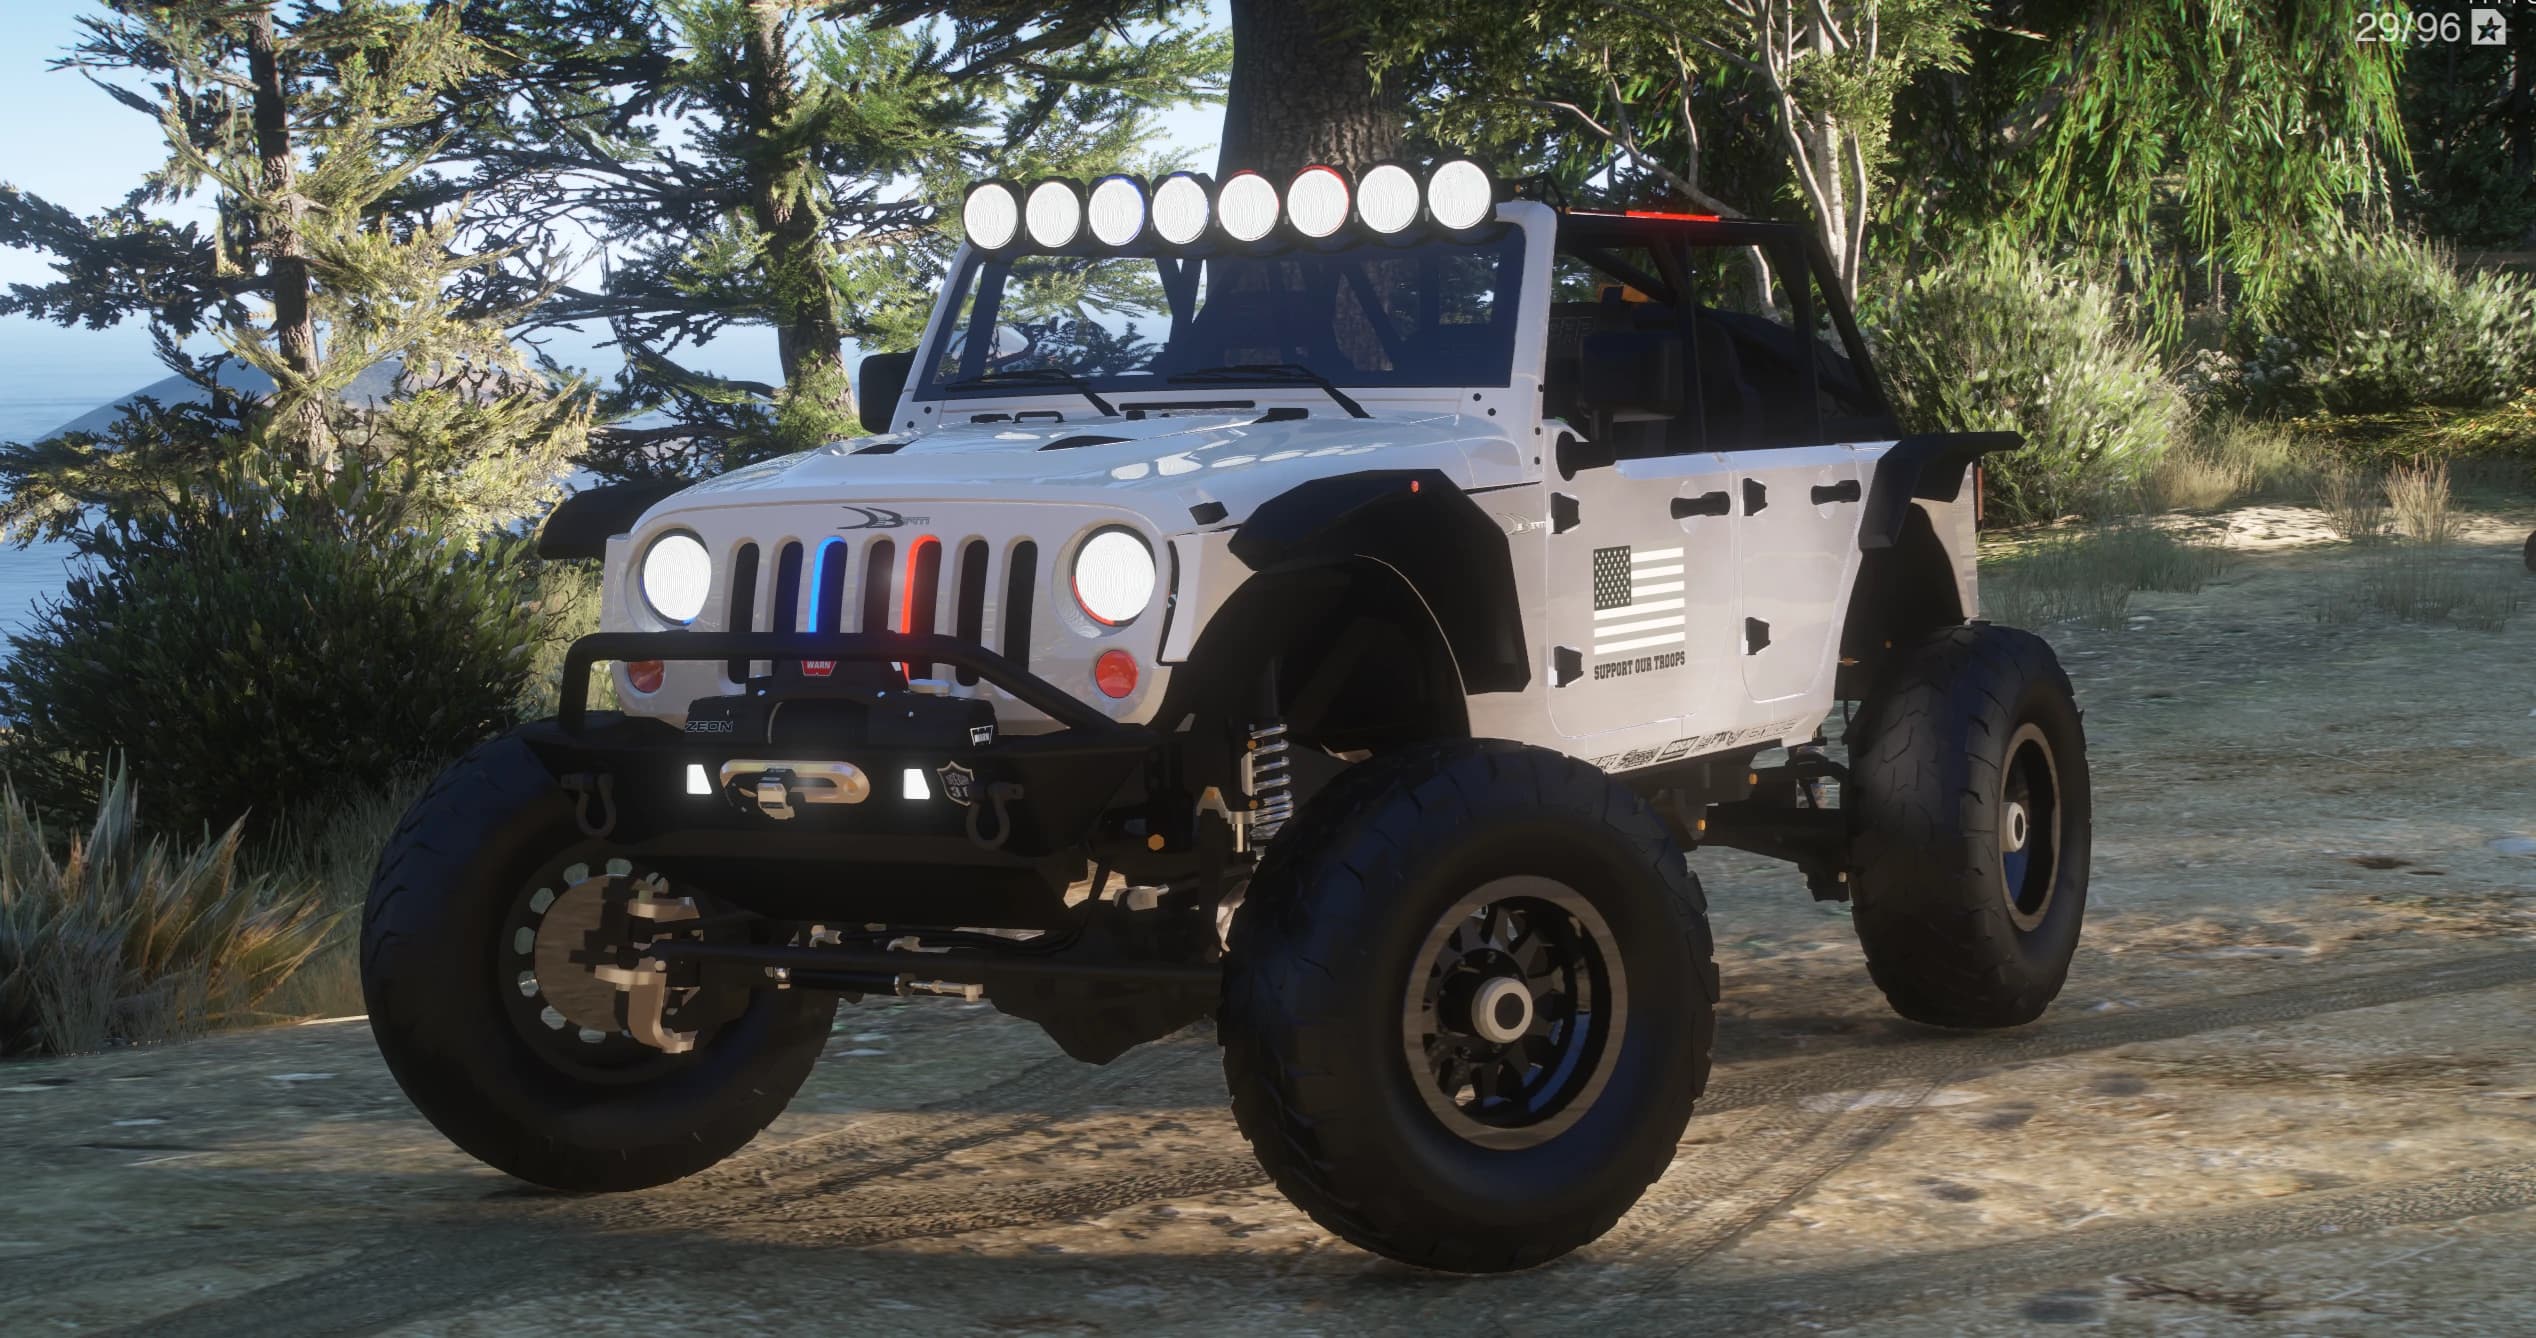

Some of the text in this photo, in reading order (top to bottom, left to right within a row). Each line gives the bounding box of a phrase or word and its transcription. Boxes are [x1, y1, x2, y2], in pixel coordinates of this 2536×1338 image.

[807, 660, 831, 669] WARN
[1594, 651, 1685, 680] SUPPORT OUR TROOPS
[684, 721, 734, 732] ZEON
